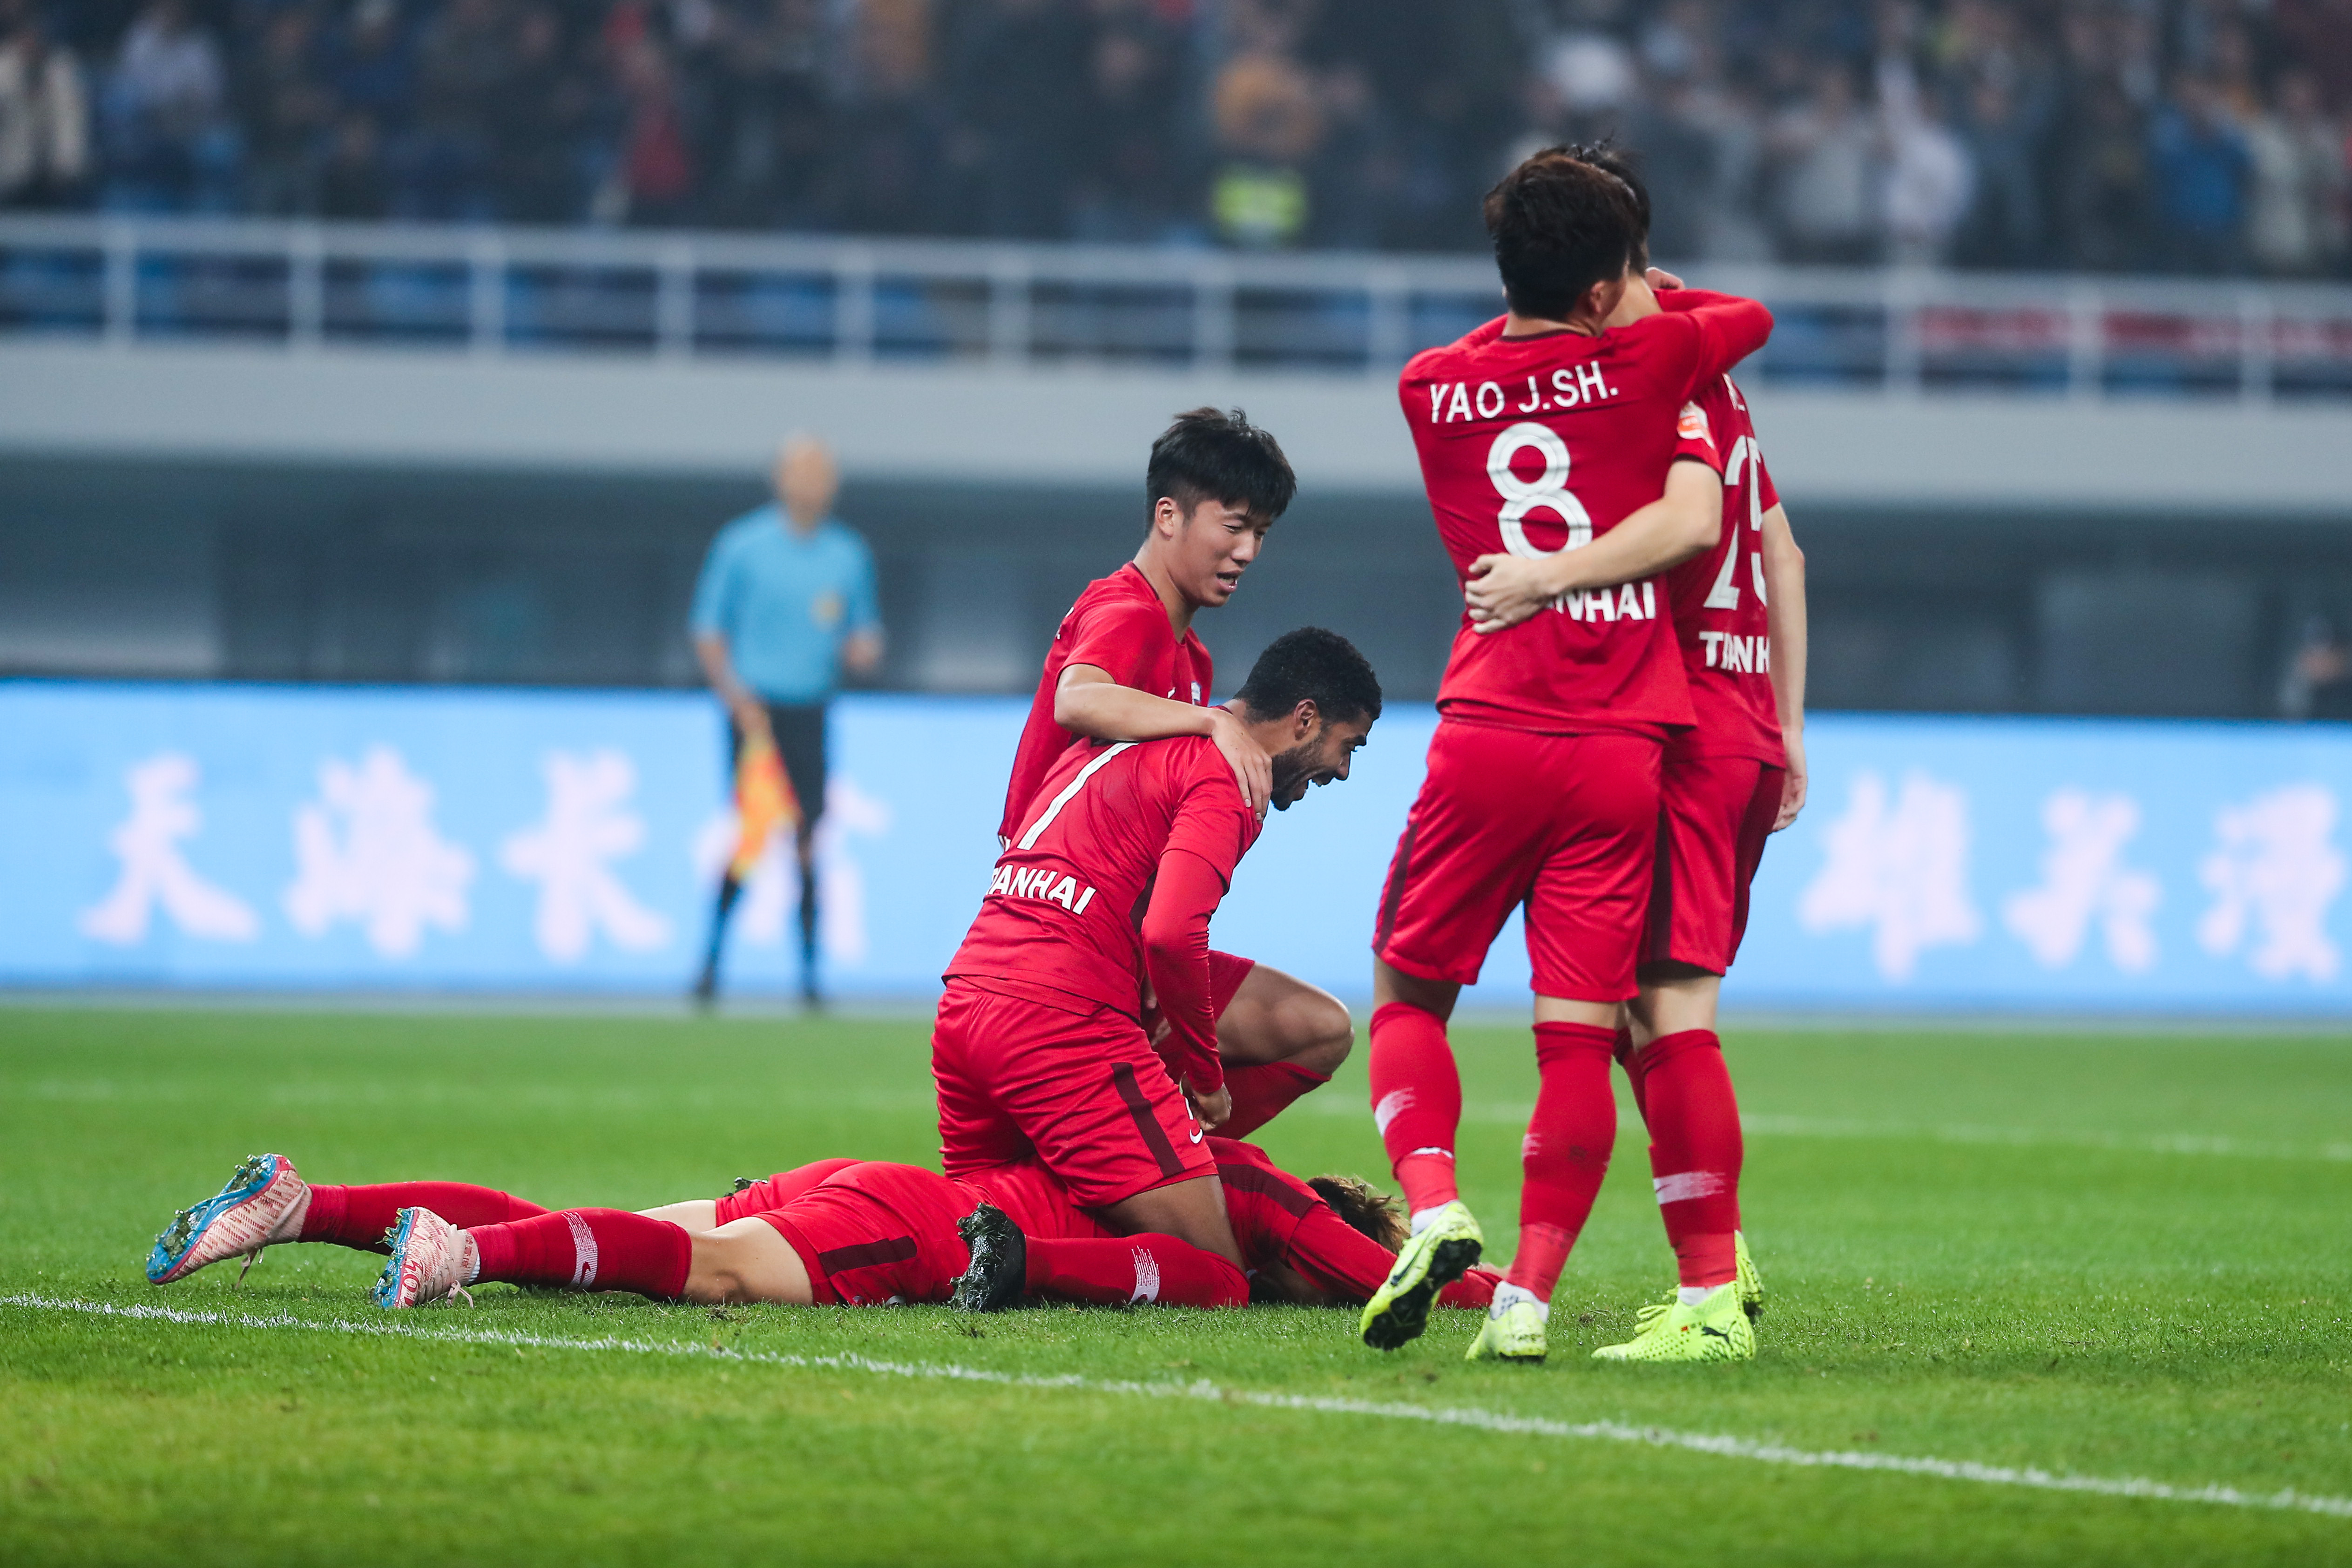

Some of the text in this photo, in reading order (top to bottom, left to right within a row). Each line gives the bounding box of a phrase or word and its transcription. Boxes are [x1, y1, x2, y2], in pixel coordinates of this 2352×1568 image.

[1430, 360, 1619, 423] YAO J.SH.
[1487, 422, 1593, 560] 8
[1547, 581, 1656, 622] NHAI
